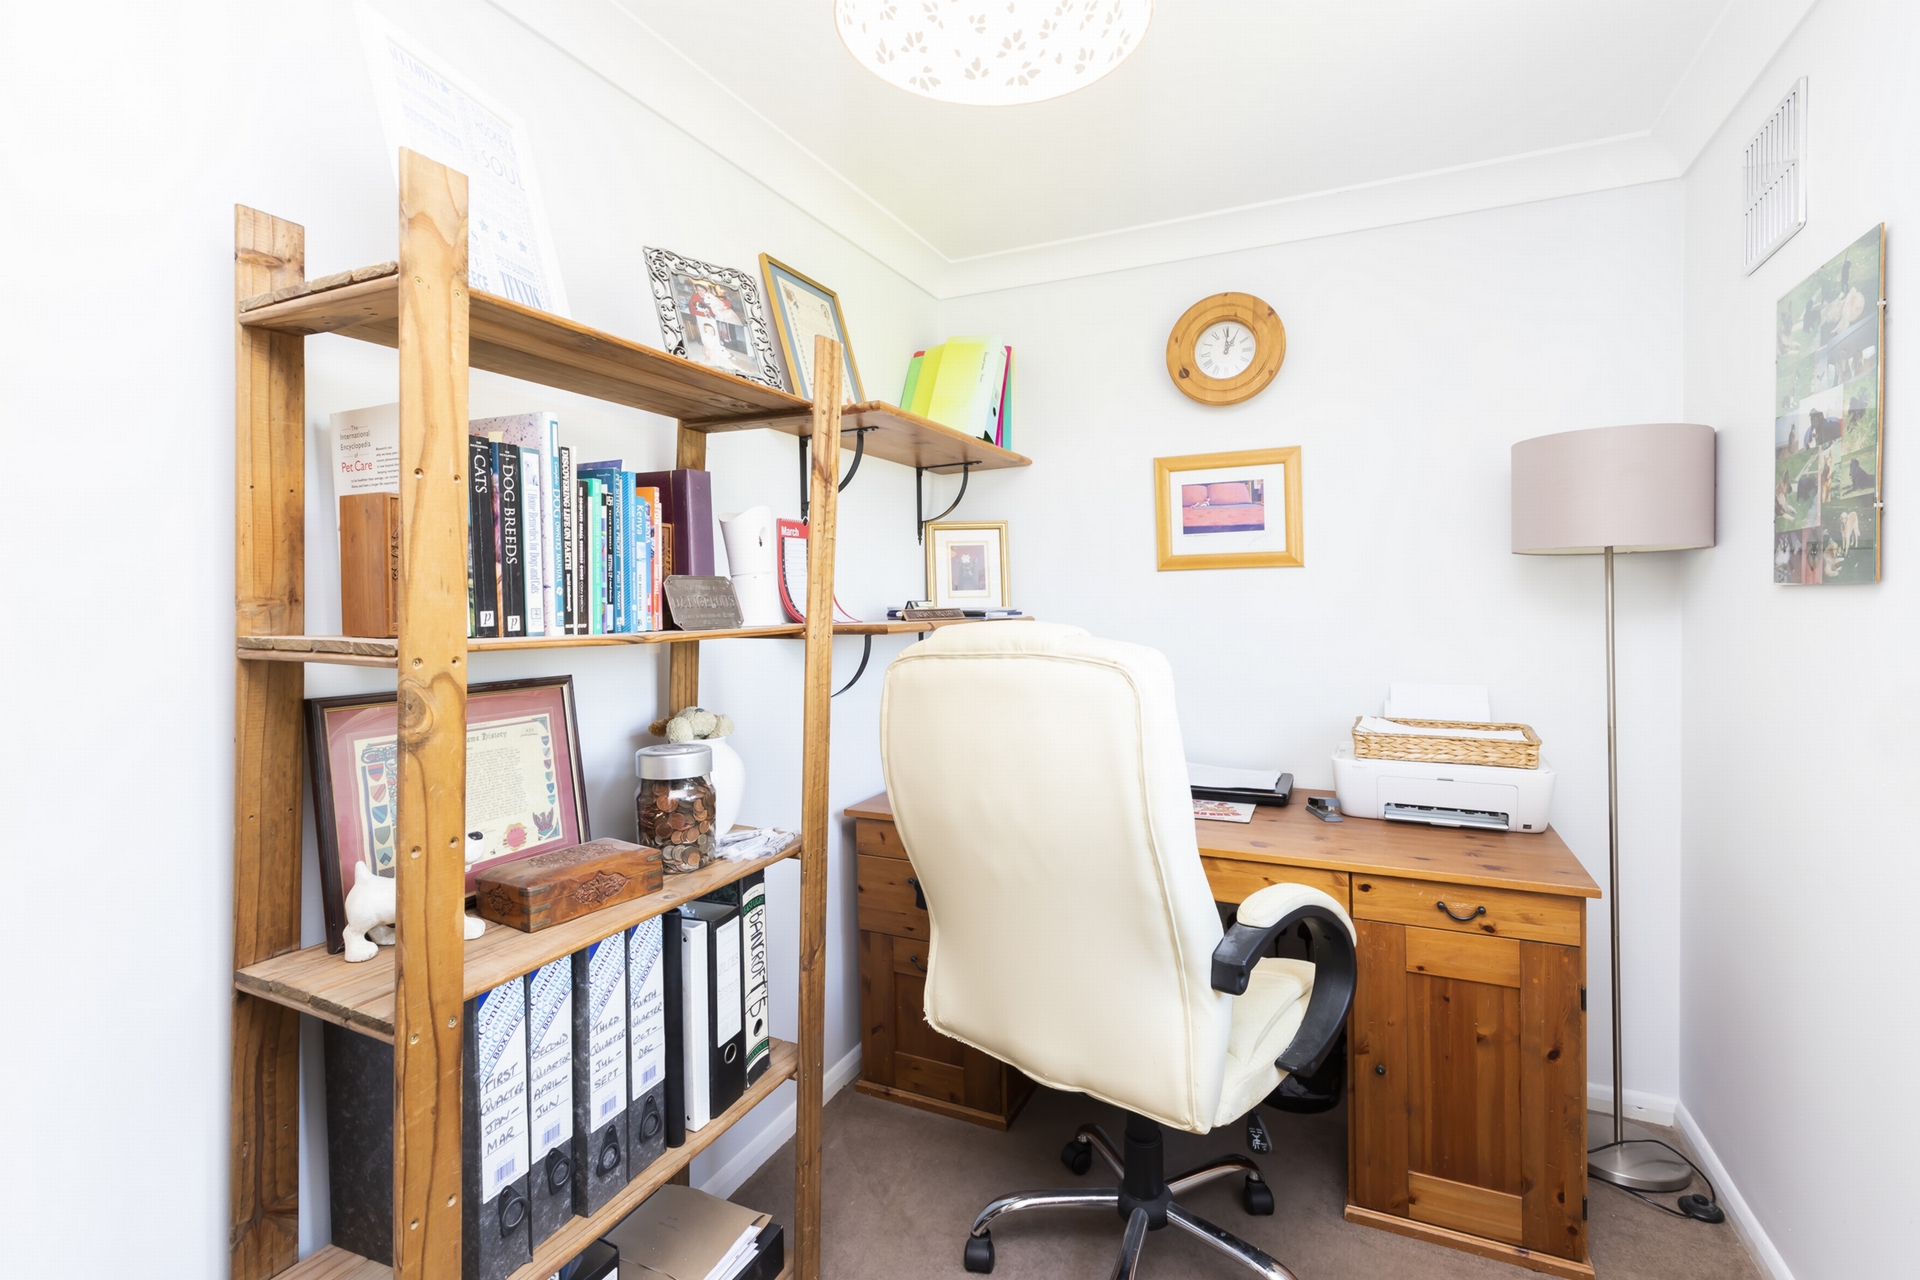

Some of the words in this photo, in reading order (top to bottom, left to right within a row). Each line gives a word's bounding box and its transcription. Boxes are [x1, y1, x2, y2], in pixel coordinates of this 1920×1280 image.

[474, 118, 508, 149] HOCKEY
[482, 150, 526, 192] SOUL
[340, 430, 370, 440] International
[340, 441, 371, 452] Encyclopedia
[341, 461, 354, 473] Pet
[354, 460, 373, 472] Care
[474, 455, 487, 493] CATS
[562, 450, 570, 507] DISCOVERING
[502, 464, 516, 502] DOG
[528, 493, 538, 511] Home
[528, 513, 539, 541] Remedies
[563, 508, 571, 527] LIFE
[636, 504, 644, 535] Kenya
[504, 507, 518, 564] BREEDS
[564, 528, 571, 540] ON
[781, 526, 800, 537] March
[528, 552, 540, 567] Dogs
[530, 543, 539, 552] for
[564, 541, 572, 570] EARTH
[530, 569, 540, 580] and
[530, 581, 541, 594] Cats
[467, 735, 480, 743] ame
[481, 731, 507, 742] History
[631, 917, 656, 962] Centurio
[589, 933, 621, 988] Centurio
[530, 958, 563, 1010] Centuri
[478, 976, 516, 1038] Centurio
[592, 1016, 619, 1036] THIRD
[532, 1033, 569, 1060] SECOND
[638, 1044, 653, 1060] DEC
[484, 1061, 518, 1094] FIRST
[594, 1068, 619, 1089] SEPT
[535, 1095, 560, 1119] JUN
[487, 1126, 515, 1155] MAR
